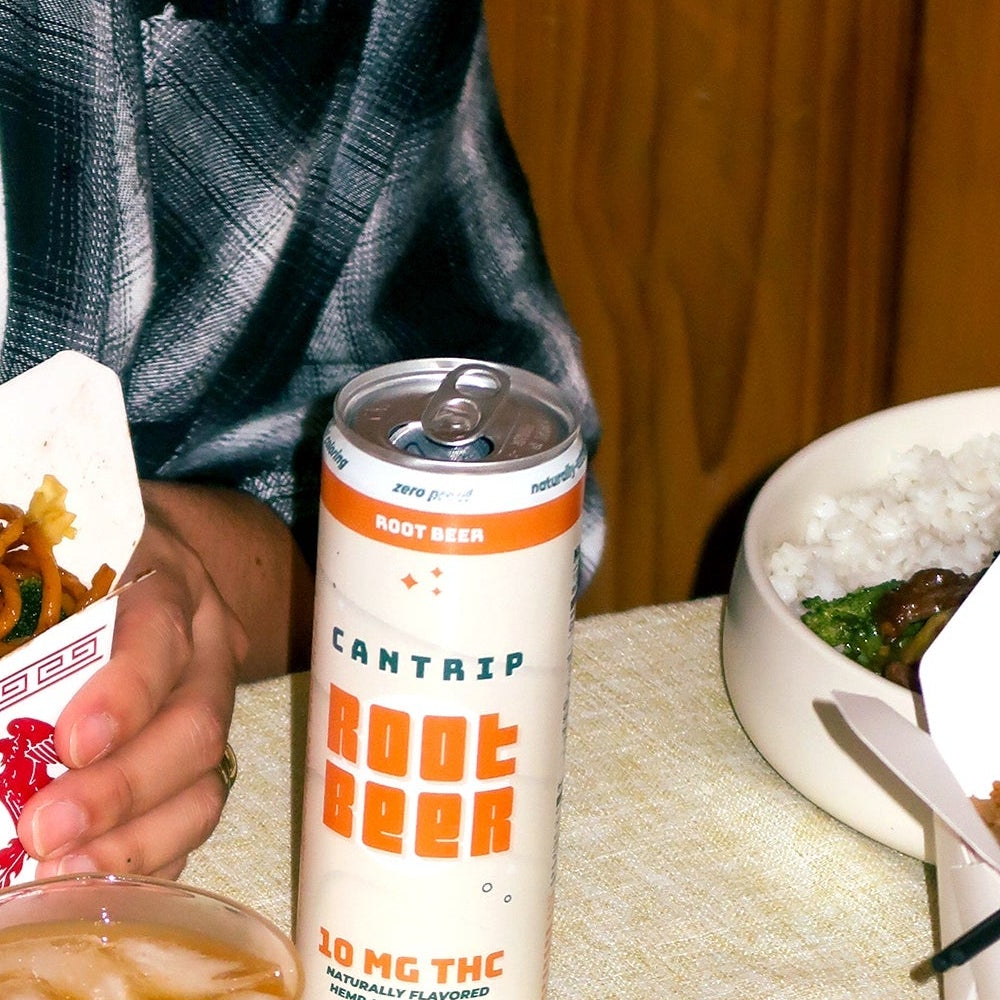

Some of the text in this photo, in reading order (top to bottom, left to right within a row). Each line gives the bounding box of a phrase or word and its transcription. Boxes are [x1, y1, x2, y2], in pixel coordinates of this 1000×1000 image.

[392, 483, 425, 498] zero
[375, 513, 485, 543] ROOT BEER
[332, 626, 524, 682] CANTRIP
[318, 926, 505, 985] 10 MG THC
[326, 965, 490, 1000] NATURALLY FLAVORED
